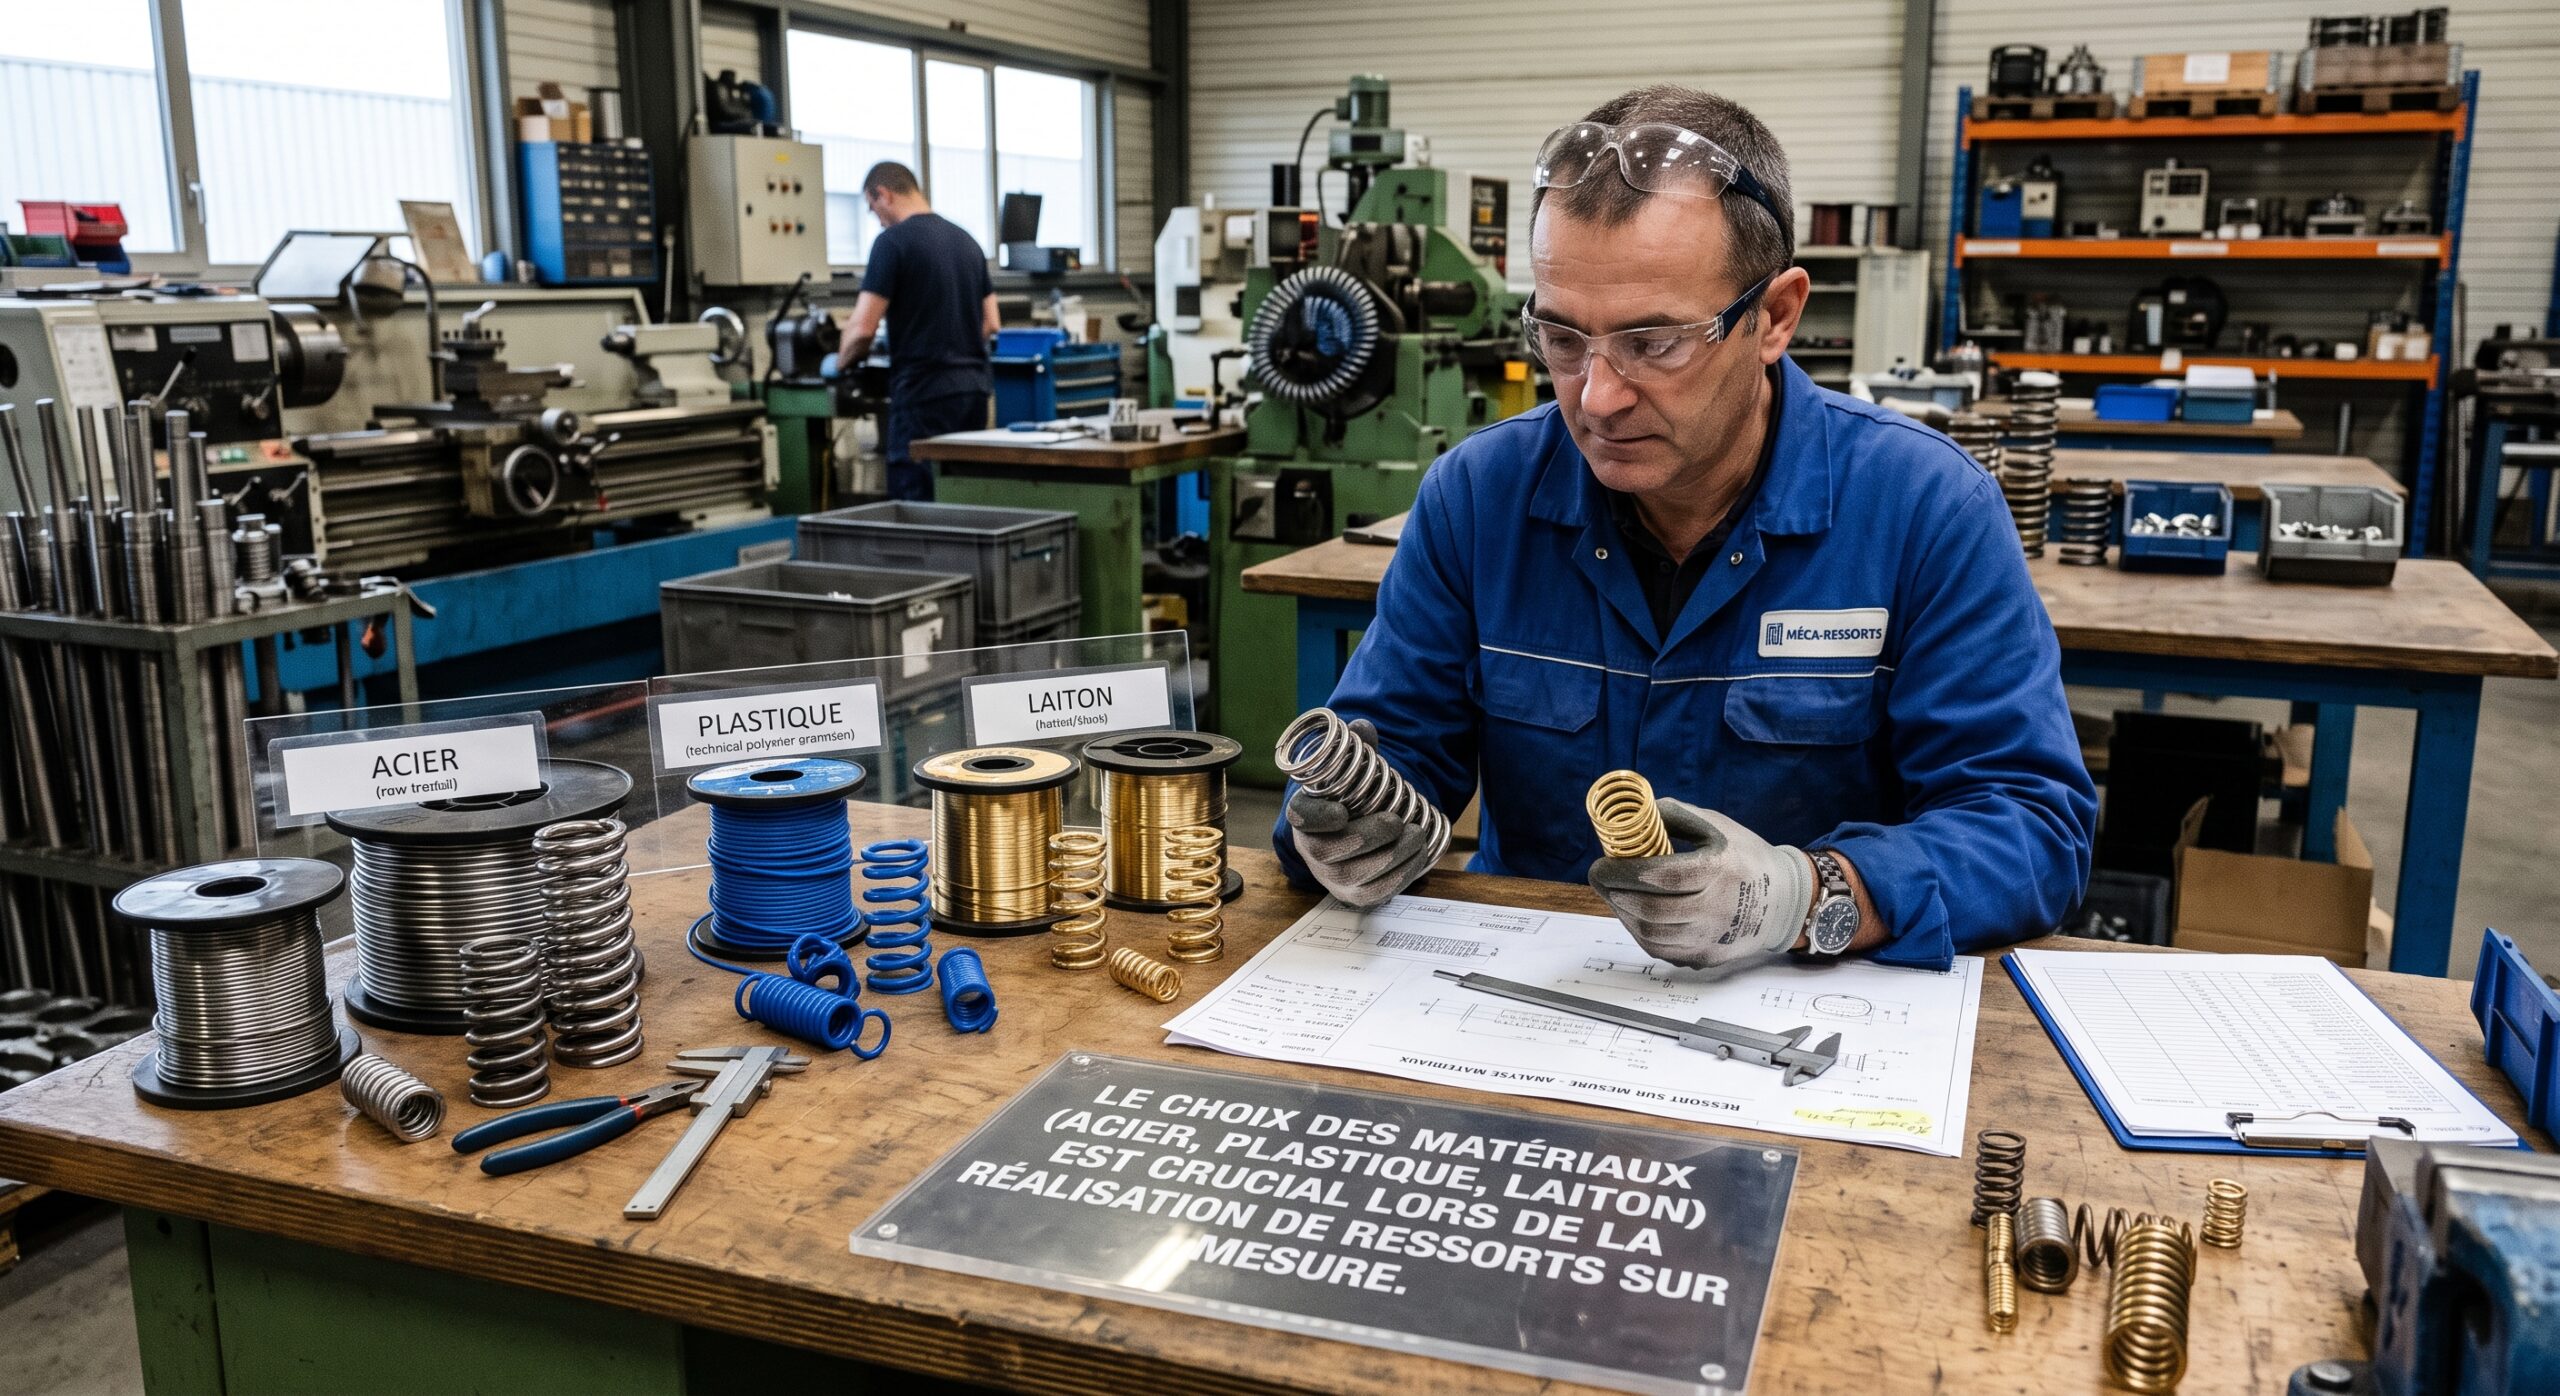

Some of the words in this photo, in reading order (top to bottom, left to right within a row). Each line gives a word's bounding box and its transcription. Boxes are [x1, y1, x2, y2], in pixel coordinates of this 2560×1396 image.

[1786, 625, 1883, 641] MÉCA-RESSORTS
[1028, 686, 1113, 714] LAITON
[698, 703, 843, 737] PLASTIQUE
[685, 740, 743, 759] (technical
[371, 750, 460, 779] ACIER
[376, 785, 407, 800] (raw
[1490, 1069, 1556, 1084] ANALYSE
[1635, 1089, 1665, 1102] SUR
[1092, 1085, 1154, 1110] LE
[1159, 1094, 1301, 1131] CHOIX
[1305, 1115, 1401, 1146] DES
[1410, 1128, 1697, 1190] MATÉRIAUX
[1043, 1108, 1201, 1155] (ACIER,
[1214, 1132, 1487, 1198] PLASTIQUE,
[1503, 1174, 1706, 1230] LAITON)
[1048, 1140, 1145, 1173] EST
[1147, 1156, 1349, 1208] CRUCIAL
[1364, 1188, 1499, 1229] LORS
[1511, 1209, 1584, 1243] DE
[1596, 1221, 1663, 1257] LA
[956, 1160, 1259, 1229] RÉALISATION
[1263, 1208, 1335, 1242] DE
[1340, 1220, 1606, 1285] RESSORTS
[1619, 1263, 1729, 1306] SUR
[1191, 1235, 1406, 1295] MESURE.
